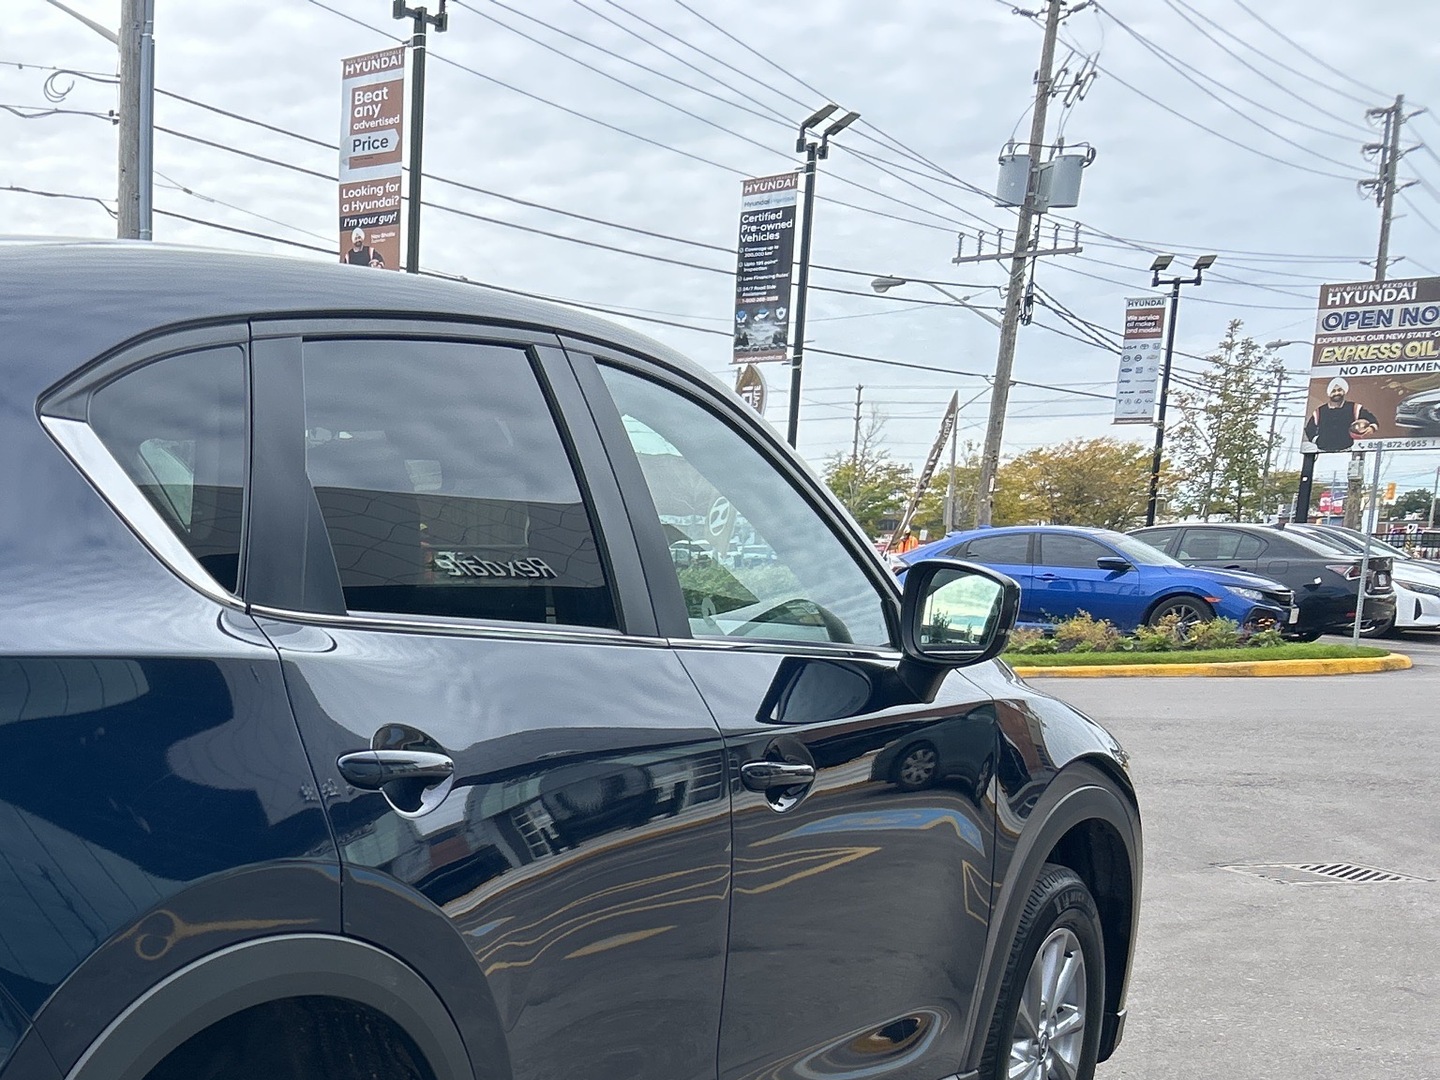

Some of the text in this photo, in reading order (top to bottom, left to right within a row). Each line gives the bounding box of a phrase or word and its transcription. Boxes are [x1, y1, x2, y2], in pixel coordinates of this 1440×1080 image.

[345, 54, 402, 76] HYUNDAI
[354, 86, 389, 105] Beat
[353, 103, 381, 118] any
[353, 114, 400, 130] advertised
[353, 135, 389, 152] Price
[342, 182, 400, 199] Looking for
[744, 177, 796, 194] HYUNDAI
[342, 195, 400, 213] a Hyundai?
[343, 211, 397, 228] I'm your guy!
[741, 210, 782, 224] Certified
[741, 219, 793, 233] Pre-owned
[740, 232, 780, 243] Vehicles
[1327, 287, 1418, 306] HYUNDAI
[1322, 305, 1440, 332] OPEN NO
[1317, 334, 1366, 344] EXPERIENCE
[1367, 333, 1385, 341] OUR
[1386, 332, 1406, 341] NEW
[1318, 340, 1439, 364] EXPRESS OIL
[1339, 362, 1440, 375] NO APPOINTMEN
[1367, 440, 1427, 448] 85-872-6955
